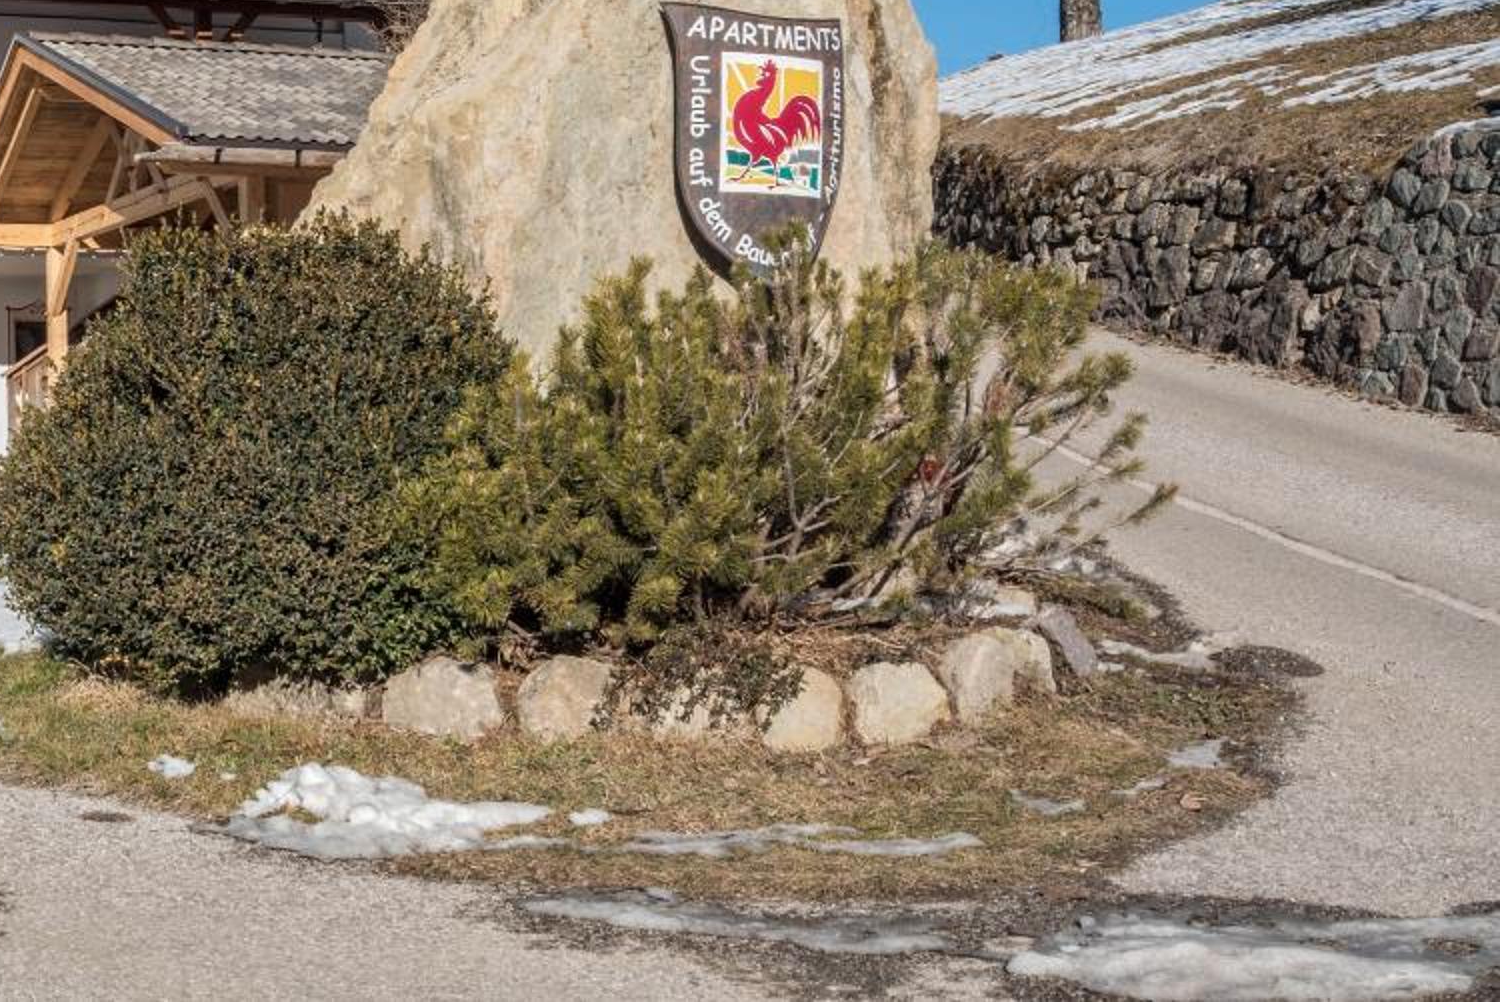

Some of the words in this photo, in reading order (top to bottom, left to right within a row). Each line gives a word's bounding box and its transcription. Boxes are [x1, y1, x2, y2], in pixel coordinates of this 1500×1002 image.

[687, 15, 842, 51] APARTMENTS
[689, 55, 712, 137] Urlaub
[689, 148, 713, 186] auf
[699, 197, 731, 243] dem
